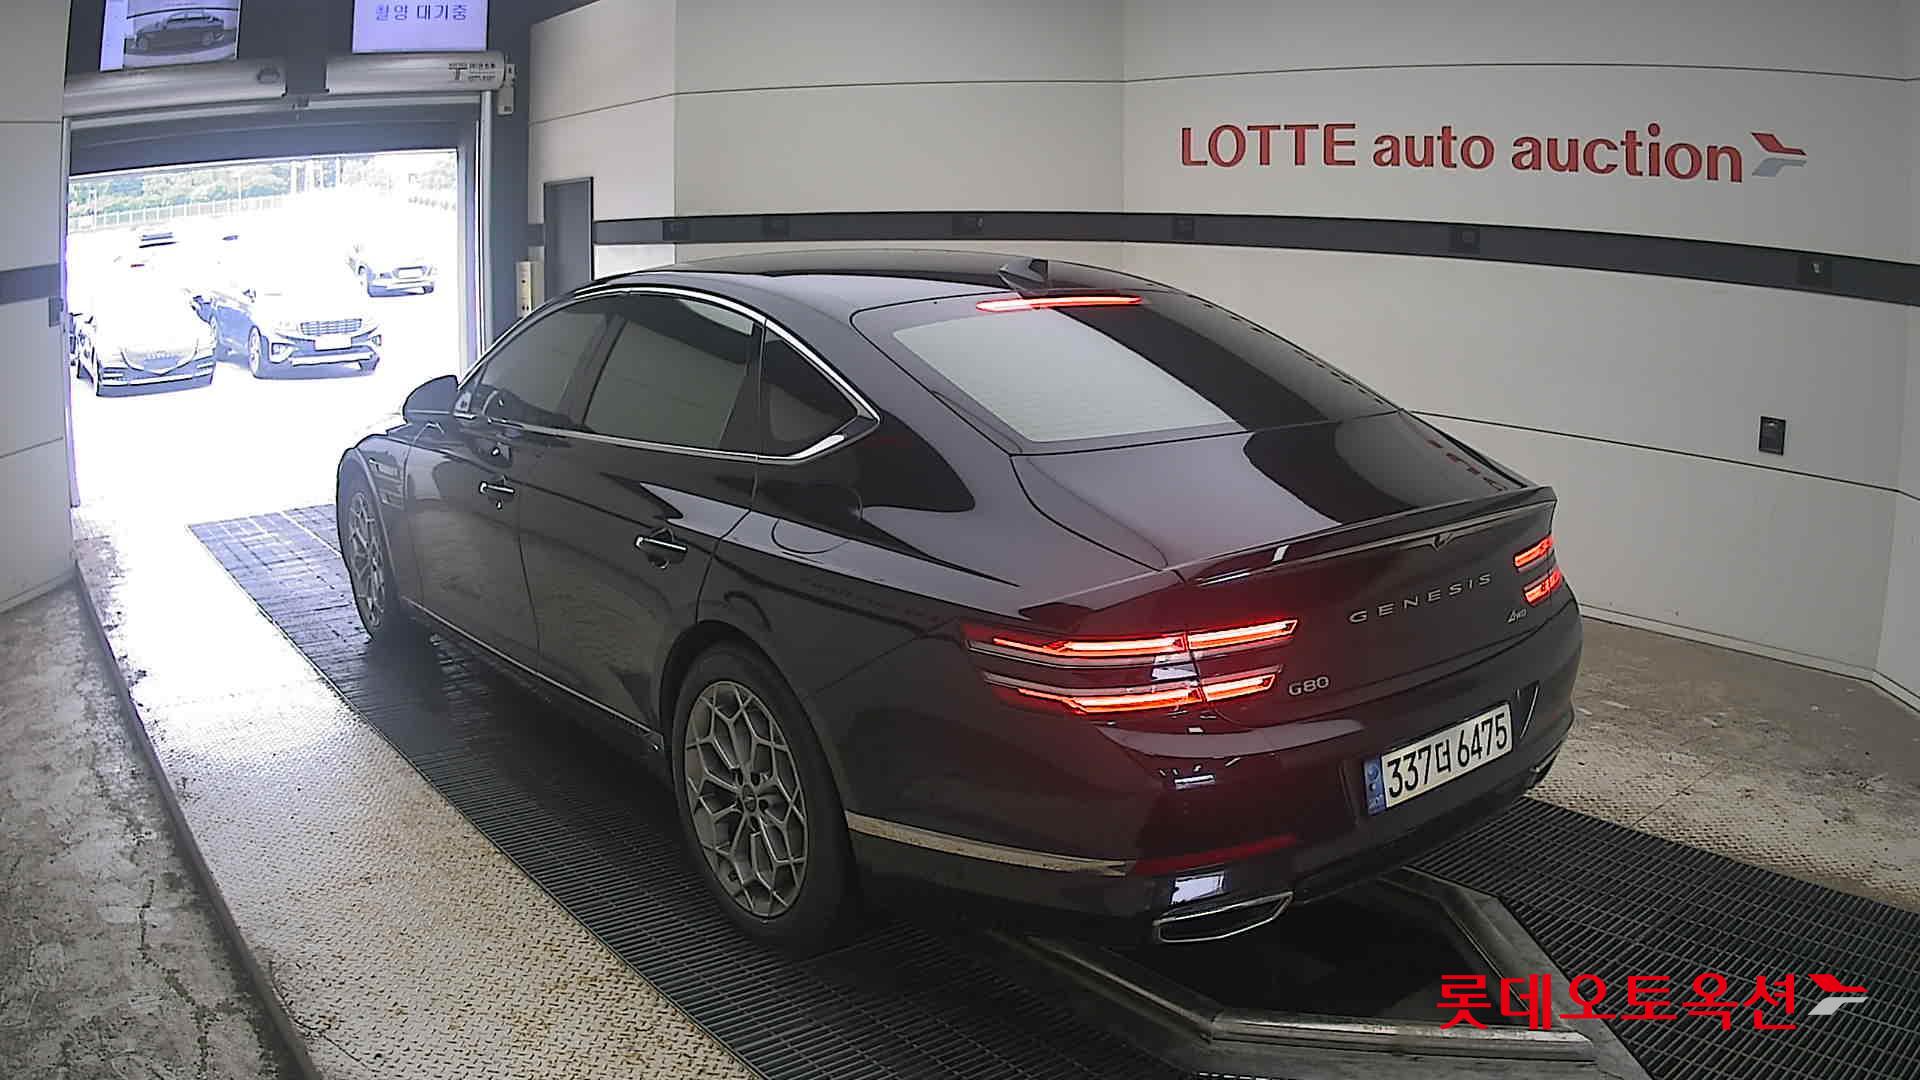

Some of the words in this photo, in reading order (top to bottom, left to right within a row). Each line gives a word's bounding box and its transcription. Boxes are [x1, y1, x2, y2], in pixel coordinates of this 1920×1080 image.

[417, 4, 467, 20] 대기중
[1180, 123, 1356, 168] LOTTE
[1373, 125, 1496, 169] auto
[1511, 122, 1743, 183] auction
[1349, 572, 1493, 624] GENESIS
[1288, 675, 1330, 696] G80
[1386, 738, 1452, 798] 337더
[1456, 712, 1508, 768] 6475
